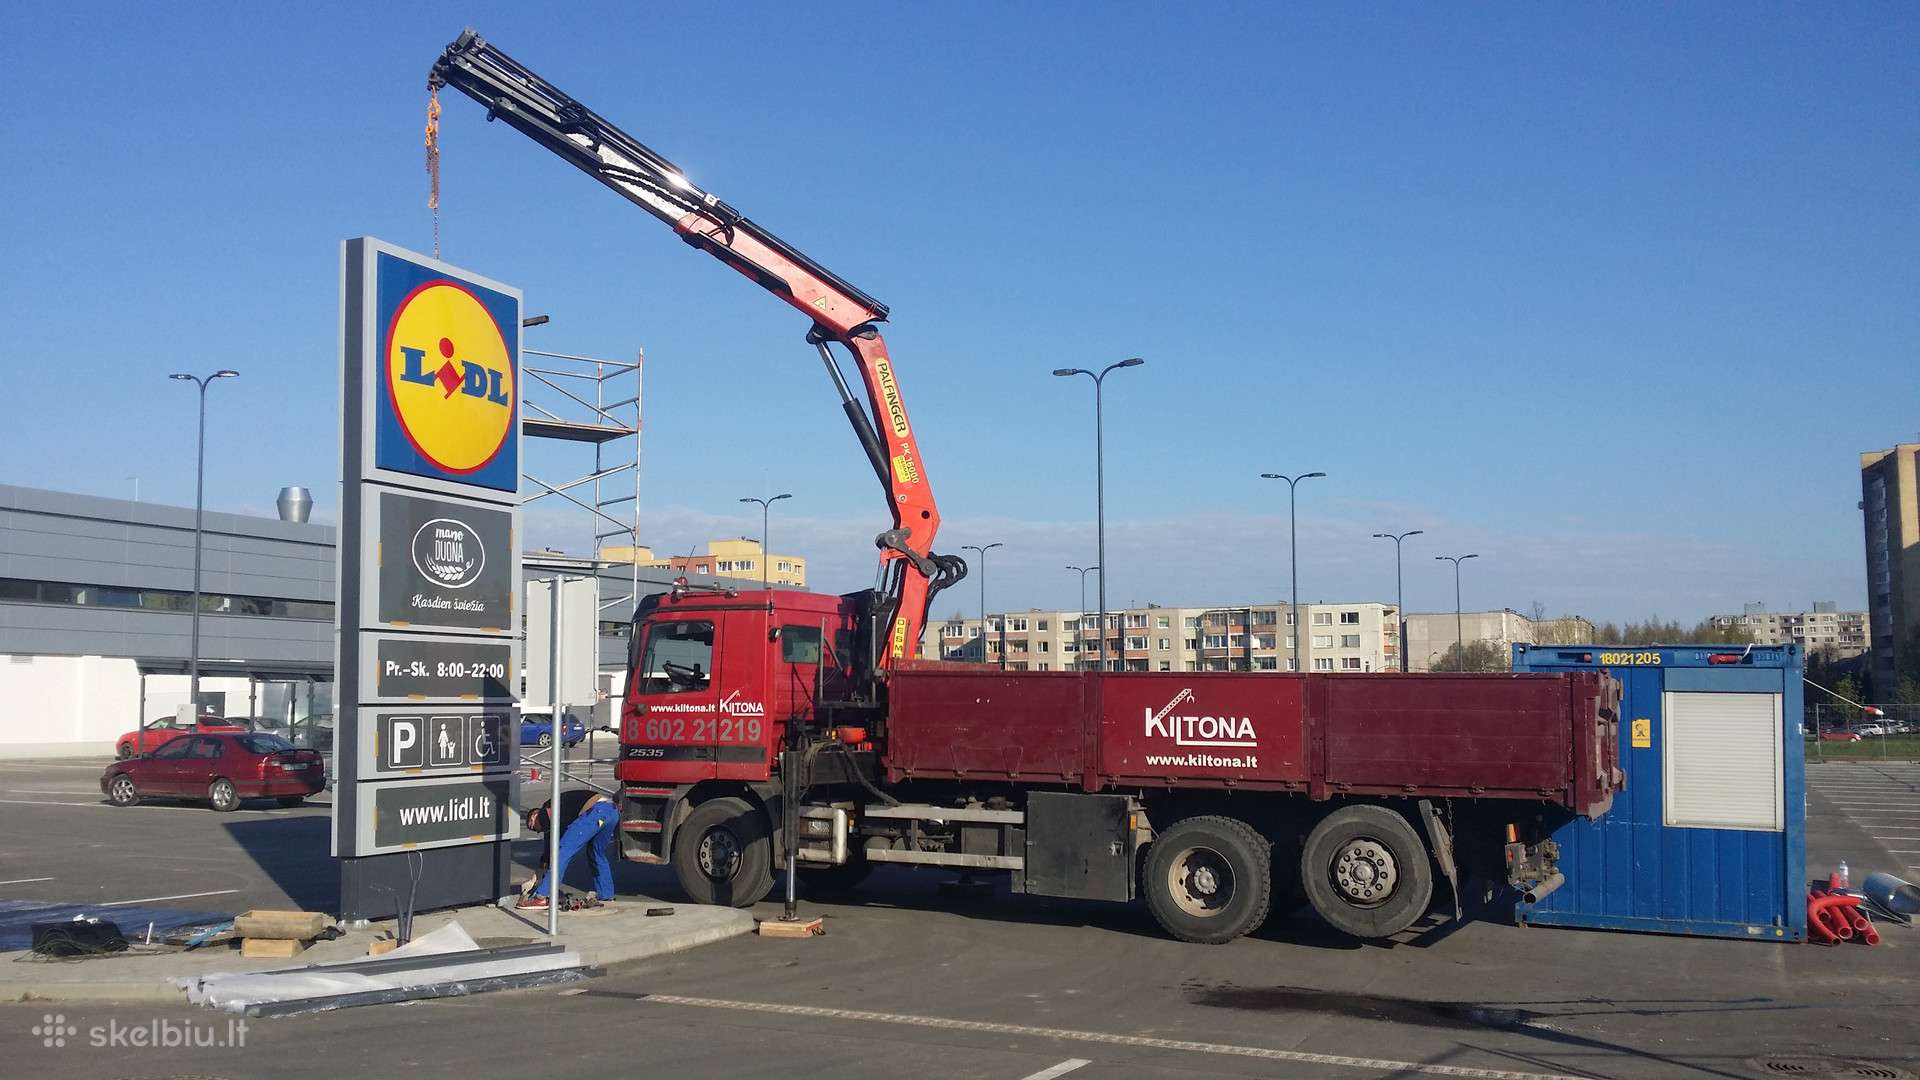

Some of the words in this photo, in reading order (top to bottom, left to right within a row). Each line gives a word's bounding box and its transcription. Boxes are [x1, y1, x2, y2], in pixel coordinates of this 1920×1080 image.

[878, 362, 906, 433] PALFINGER
[901, 442, 911, 456] PK
[435, 528, 464, 541] mano
[435, 540, 464, 563] DUONA
[412, 594, 451, 609] Kasdien
[1600, 653, 1661, 665] 18021205
[650, 704, 716, 713] www.kiltona.lt
[627, 719, 639, 740] 8
[646, 719, 685, 740] 602
[692, 718, 761, 742] 21219
[393, 722, 416, 763] P
[629, 748, 664, 758] 2535
[1146, 754, 1257, 768] www.kiltona.lt
[400, 796, 490, 826] www.lidl.lt
